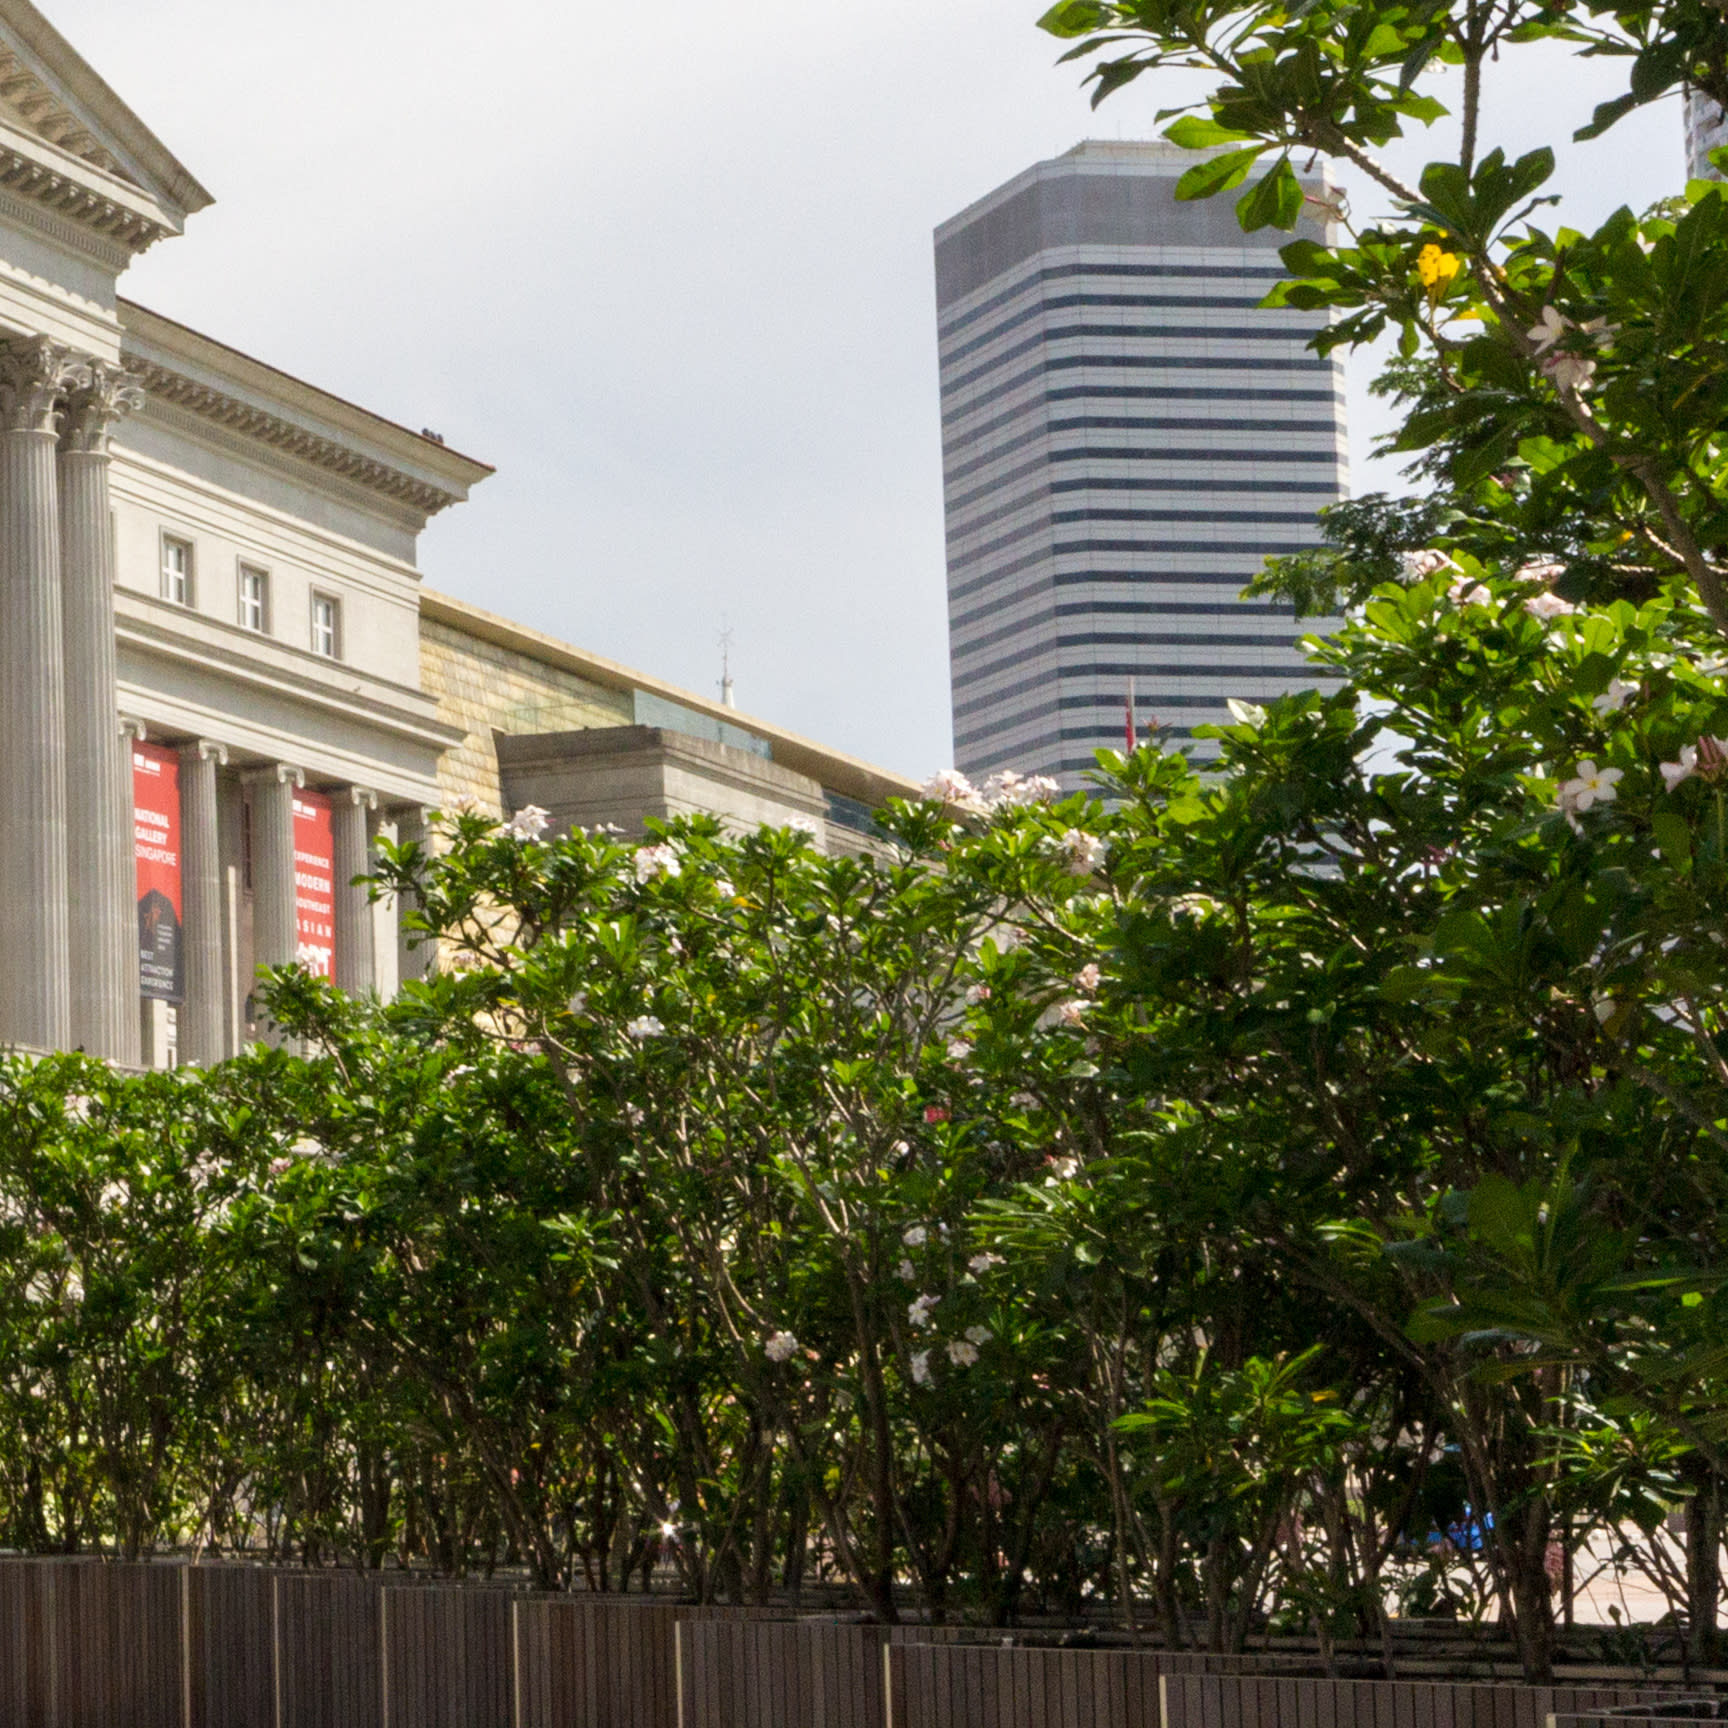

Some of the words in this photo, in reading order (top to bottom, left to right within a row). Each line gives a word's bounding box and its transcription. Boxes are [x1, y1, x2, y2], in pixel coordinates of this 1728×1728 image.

[134, 807, 170, 829] NATIONAL
[135, 825, 168, 846] GALLERY
[135, 843, 177, 866] SINGAPORE
